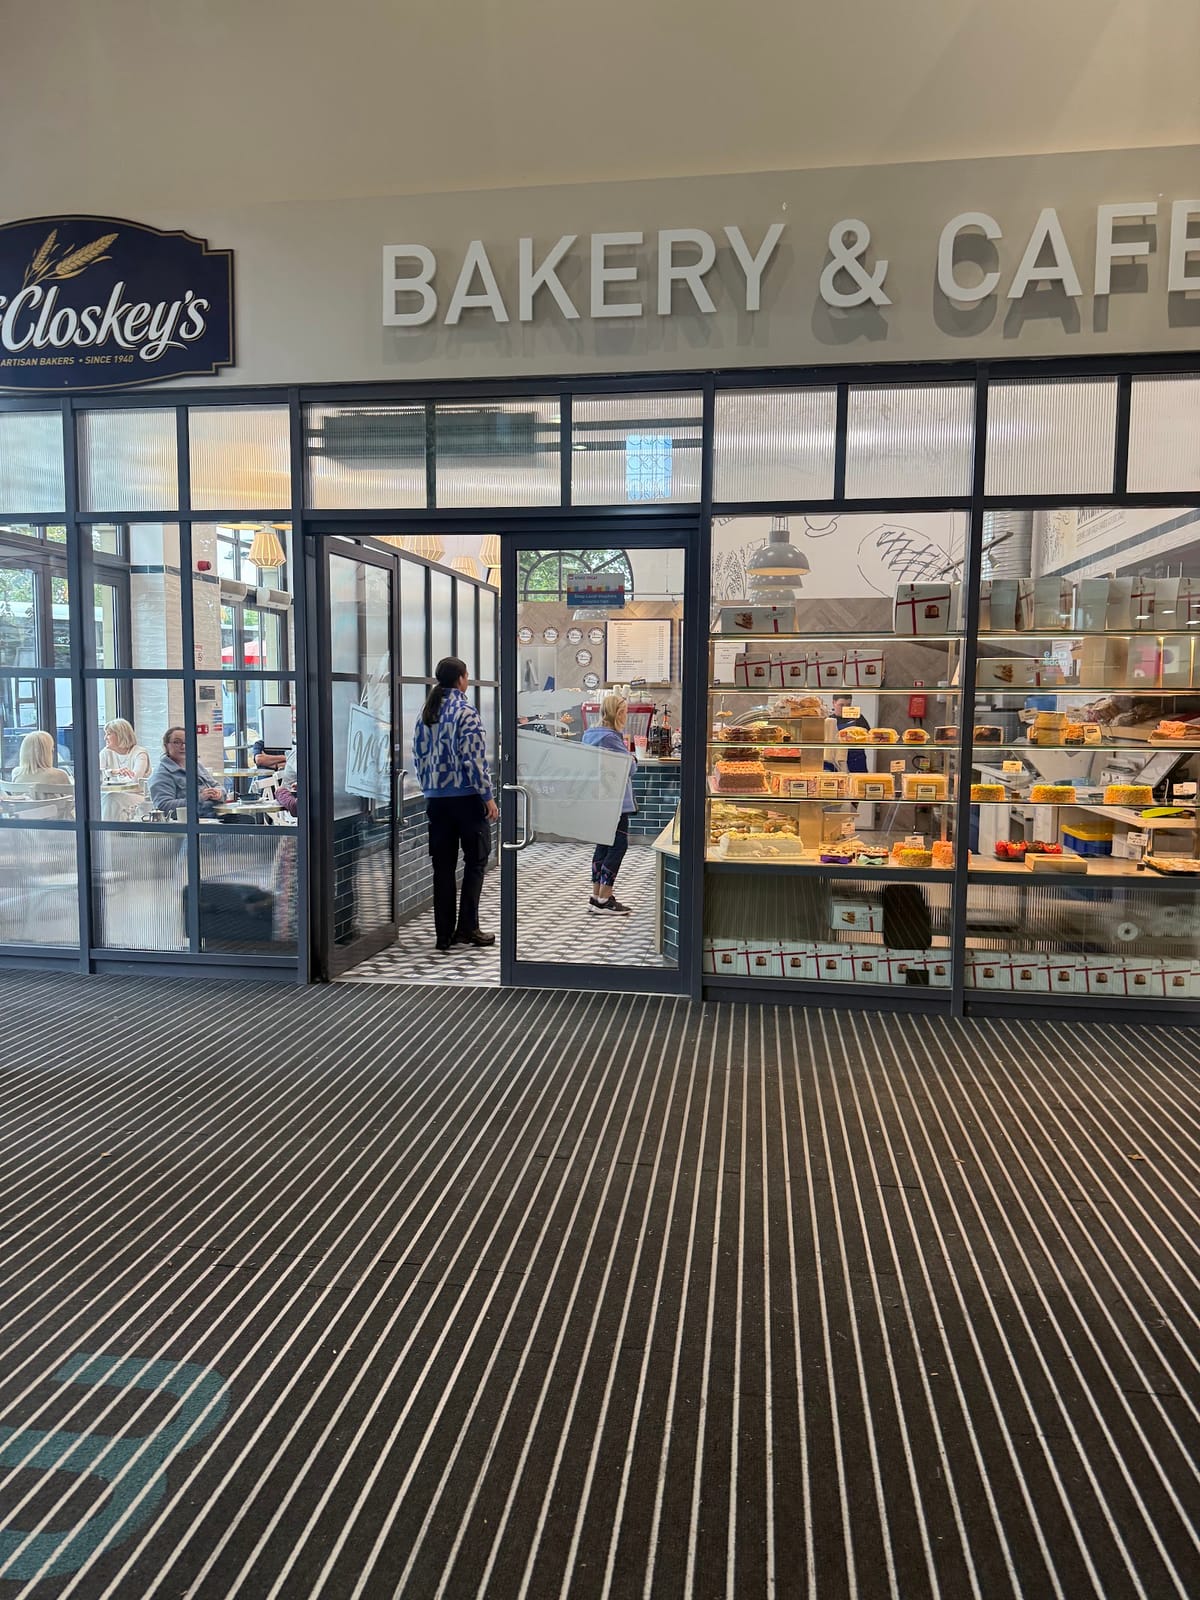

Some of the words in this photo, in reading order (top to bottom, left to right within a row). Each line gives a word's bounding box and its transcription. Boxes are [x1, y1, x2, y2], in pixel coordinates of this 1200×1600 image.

[382, 223, 786, 326] BAKERY
[818, 218, 892, 307] &
[936, 200, 1200, 302] CAFE
[0, 357, 37, 367] ARTISAN
[39, 356, 75, 366] BAKERS
[85, 355, 112, 364] SINCE
[114, 354, 134, 364] 1940
